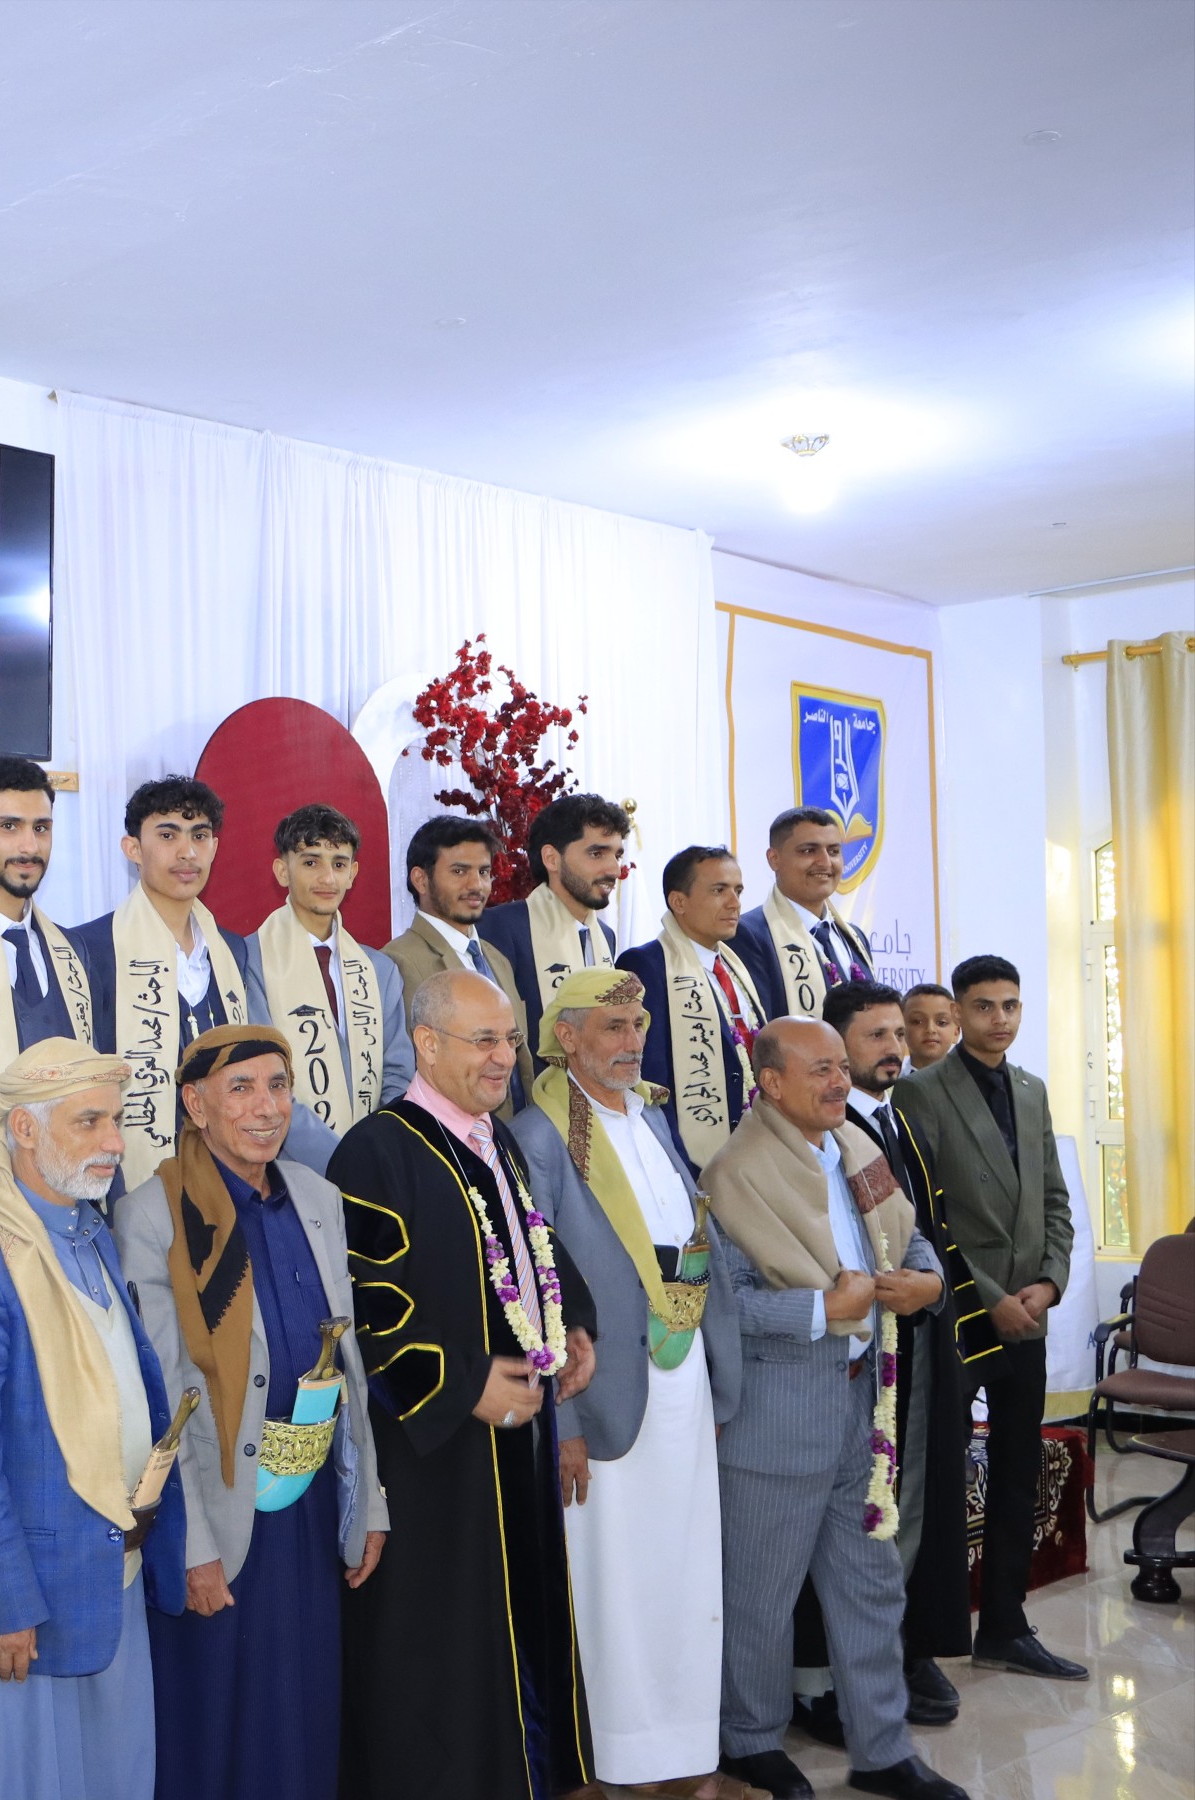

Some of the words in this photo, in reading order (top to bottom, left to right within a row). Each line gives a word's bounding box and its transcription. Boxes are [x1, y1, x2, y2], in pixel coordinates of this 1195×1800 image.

[803, 709, 830, 724] الناصر
[852, 712, 877, 736] جامعة
[870, 918, 911, 962] جامع
[299, 1019, 336, 1130] 202
